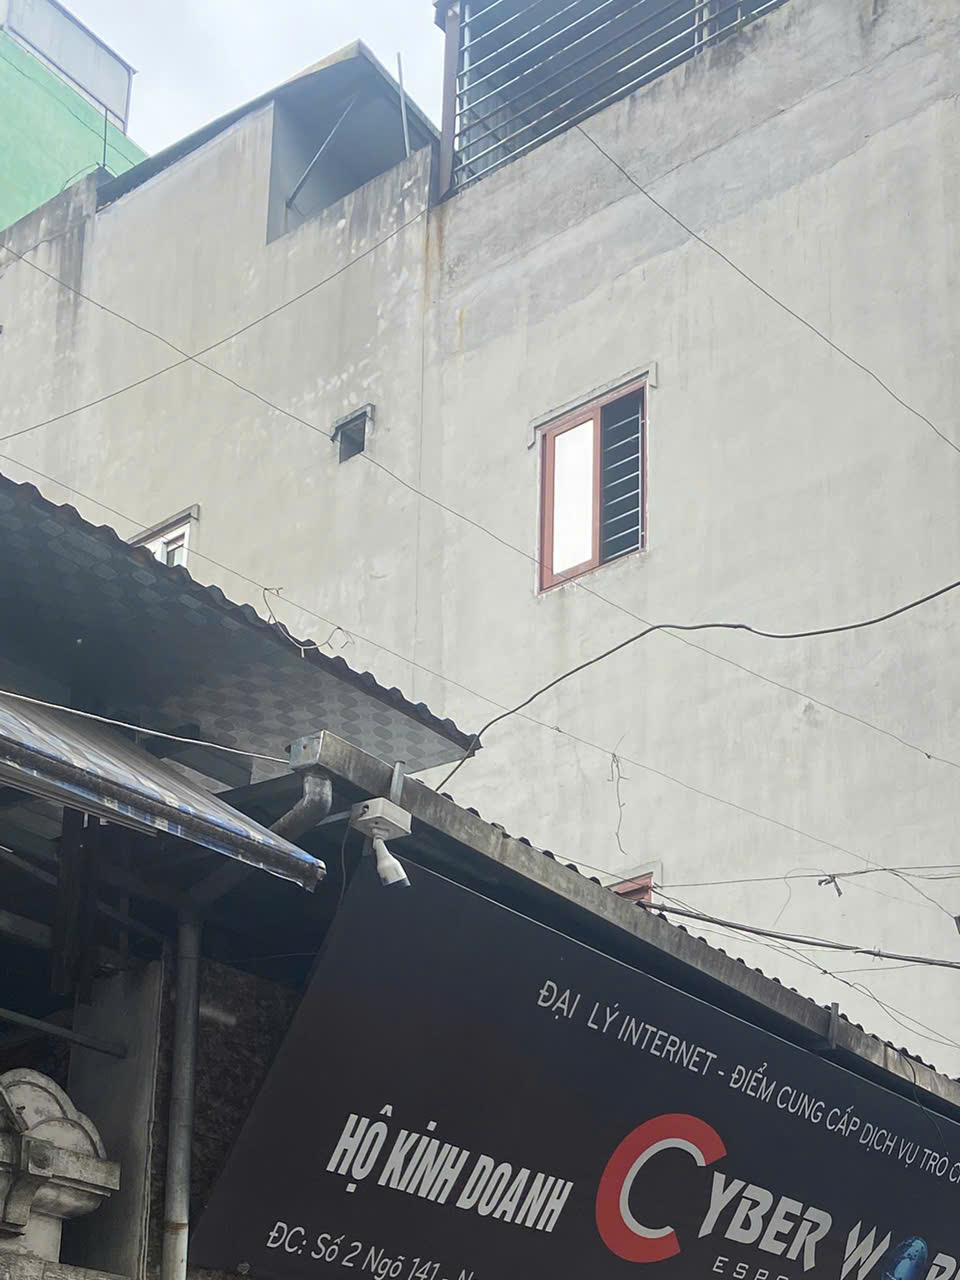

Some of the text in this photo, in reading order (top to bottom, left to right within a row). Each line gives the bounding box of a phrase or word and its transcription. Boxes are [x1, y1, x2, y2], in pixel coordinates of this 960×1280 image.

[538, 979, 580, 1020] ĐẠI
[587, 1002, 619, 1034] LÝ
[618, 1014, 718, 1077] INTERNET
[730, 1061, 775, 1104] ĐIỂM
[776, 1086, 823, 1125] CUNG
[826, 1104, 860, 1138] CẤP
[860, 1121, 895, 1154] DỊCH
[895, 1136, 919, 1166] VỤ
[920, 1146, 949, 1177] TRÒ
[326, 1104, 393, 1193] HỘ
[455, 1153, 574, 1233] DOANH
[595, 1112, 833, 1272] CYBER
[266, 1221, 308, 1255] ĐC:
[311, 1232, 346, 1264] Số
[341, 1241, 364, 1268] 2
[362, 1246, 403, 1280] Ngõ
